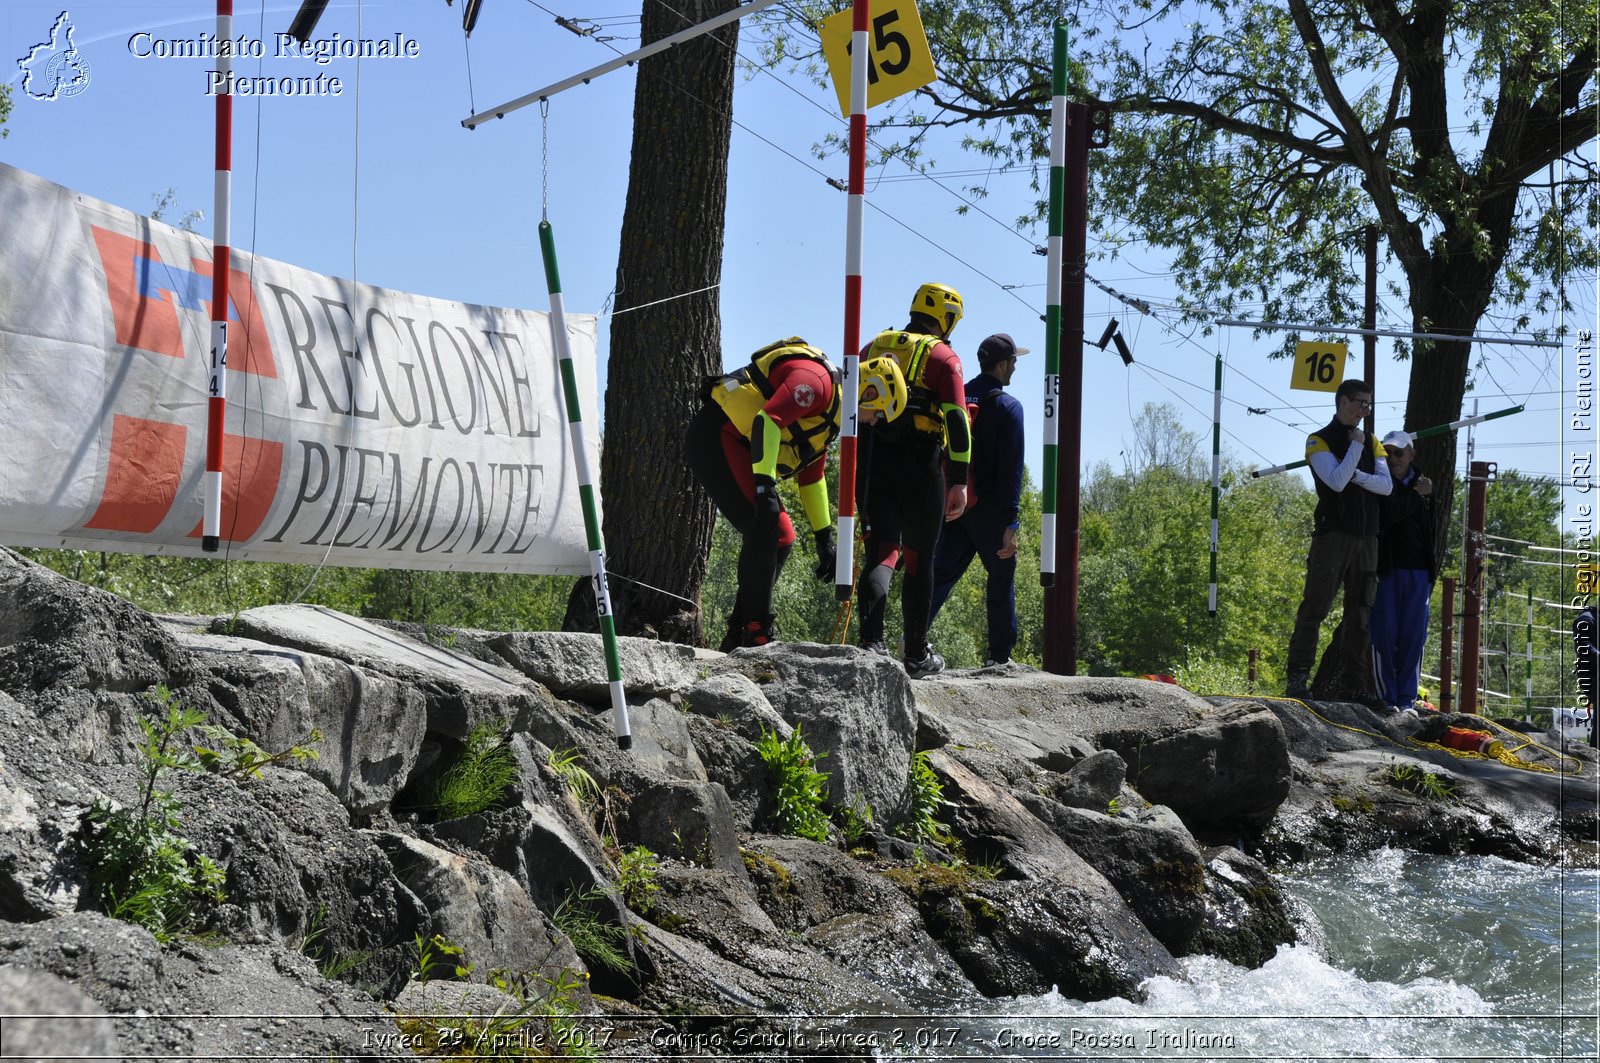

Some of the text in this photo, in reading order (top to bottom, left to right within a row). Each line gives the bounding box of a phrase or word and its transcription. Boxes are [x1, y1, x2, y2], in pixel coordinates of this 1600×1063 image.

[846, 9, 910, 85] 15
[265, 282, 541, 438] REGIONE
[1305, 352, 1336, 384] 16
[263, 439, 544, 554] PIEMONTE
